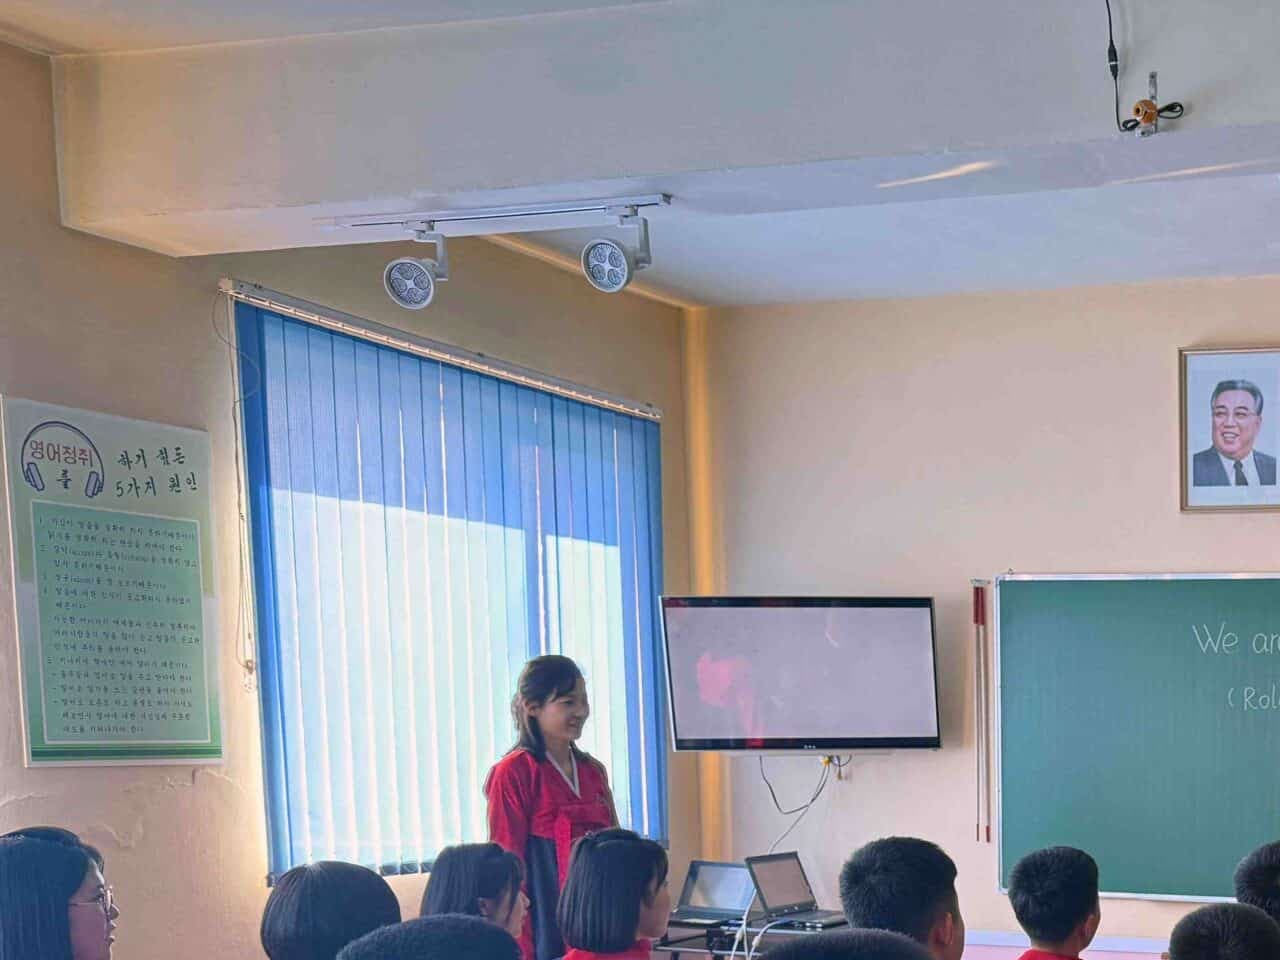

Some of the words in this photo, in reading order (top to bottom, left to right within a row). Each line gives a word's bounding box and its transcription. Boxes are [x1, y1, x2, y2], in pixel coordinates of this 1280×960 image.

[115, 475, 157, 498] 5가지
[168, 472, 198, 493] 원인
[1191, 621, 1239, 654] We
